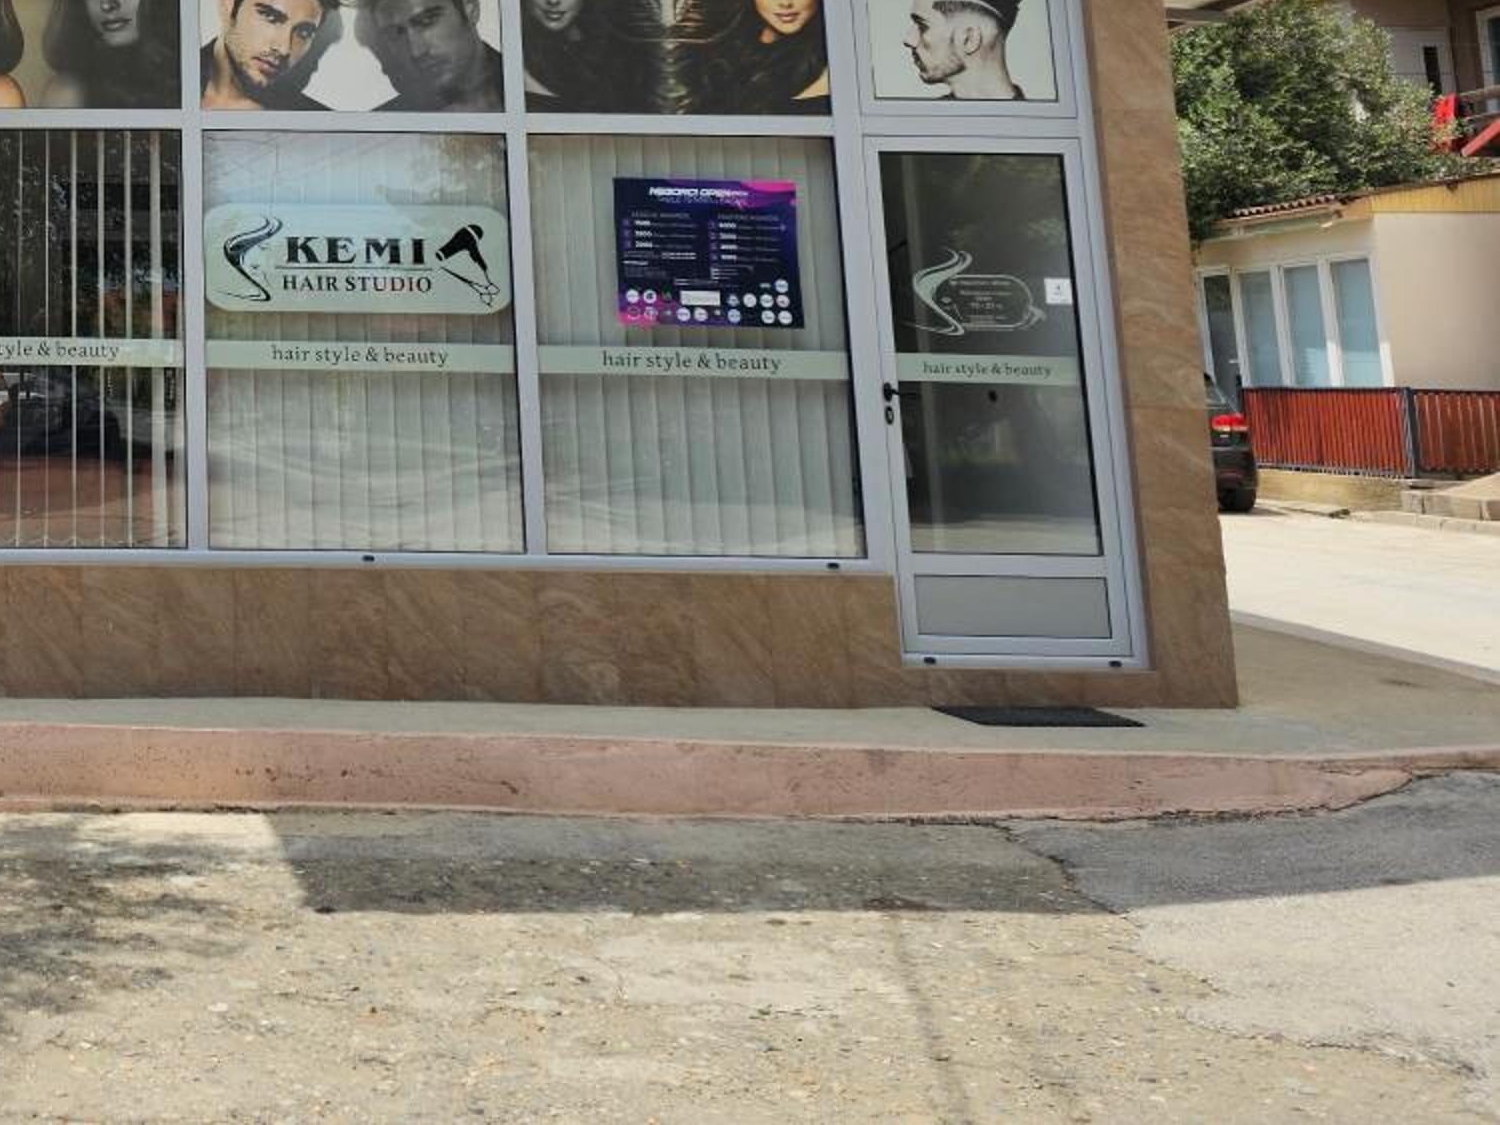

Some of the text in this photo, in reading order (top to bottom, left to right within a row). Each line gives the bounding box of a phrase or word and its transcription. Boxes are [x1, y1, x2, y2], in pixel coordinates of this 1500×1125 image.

[284, 236, 425, 264] KEMI
[283, 274, 431, 293] HAIR STUDIO
[37, 342, 51, 356] &
[57, 341, 120, 362] beauty
[272, 345, 449, 367] hair style & beauty
[602, 350, 782, 374] hair style & beauty
[923, 361, 1052, 378] hair style & beauty
